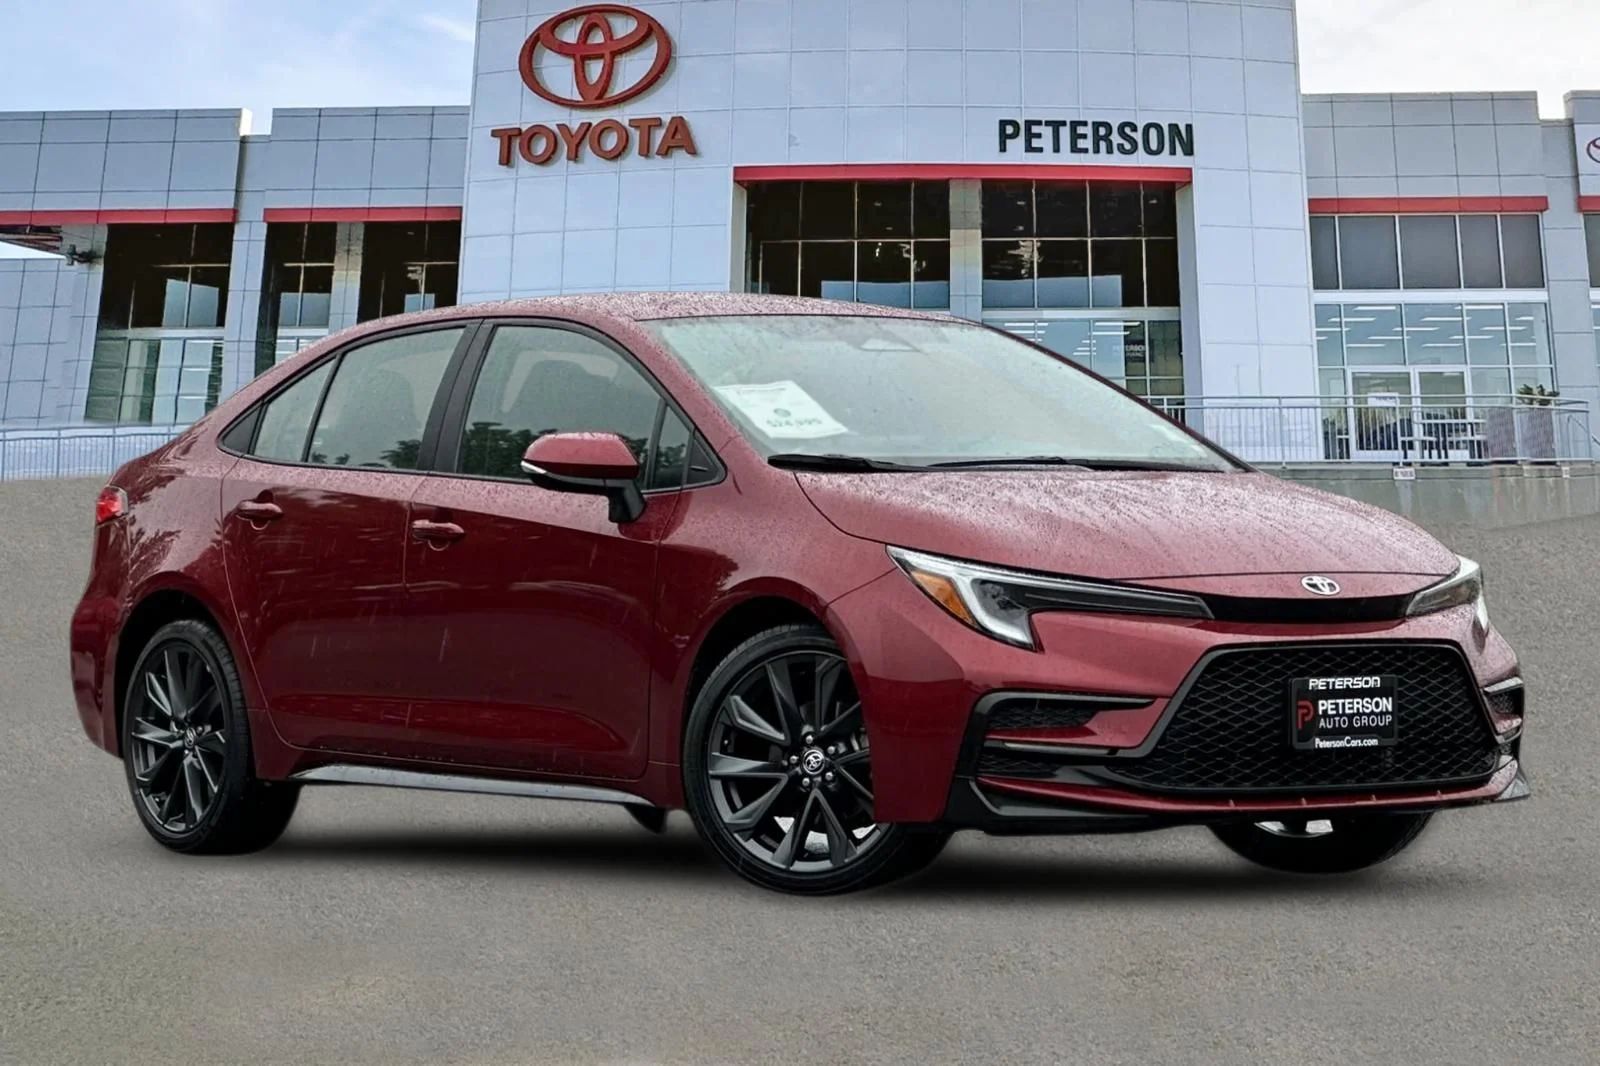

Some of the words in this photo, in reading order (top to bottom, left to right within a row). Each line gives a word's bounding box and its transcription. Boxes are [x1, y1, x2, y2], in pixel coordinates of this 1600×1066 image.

[491, 116, 697, 167] TOYOTA
[998, 119, 1194, 157] PETERSON
[1309, 677, 1381, 690] PETERSON
[1318, 697, 1393, 715] PETERSON
[1319, 717, 1349, 728] AUTO
[1353, 715, 1392, 727] GROUP
[1315, 737, 1378, 749] PetersonCars.com
